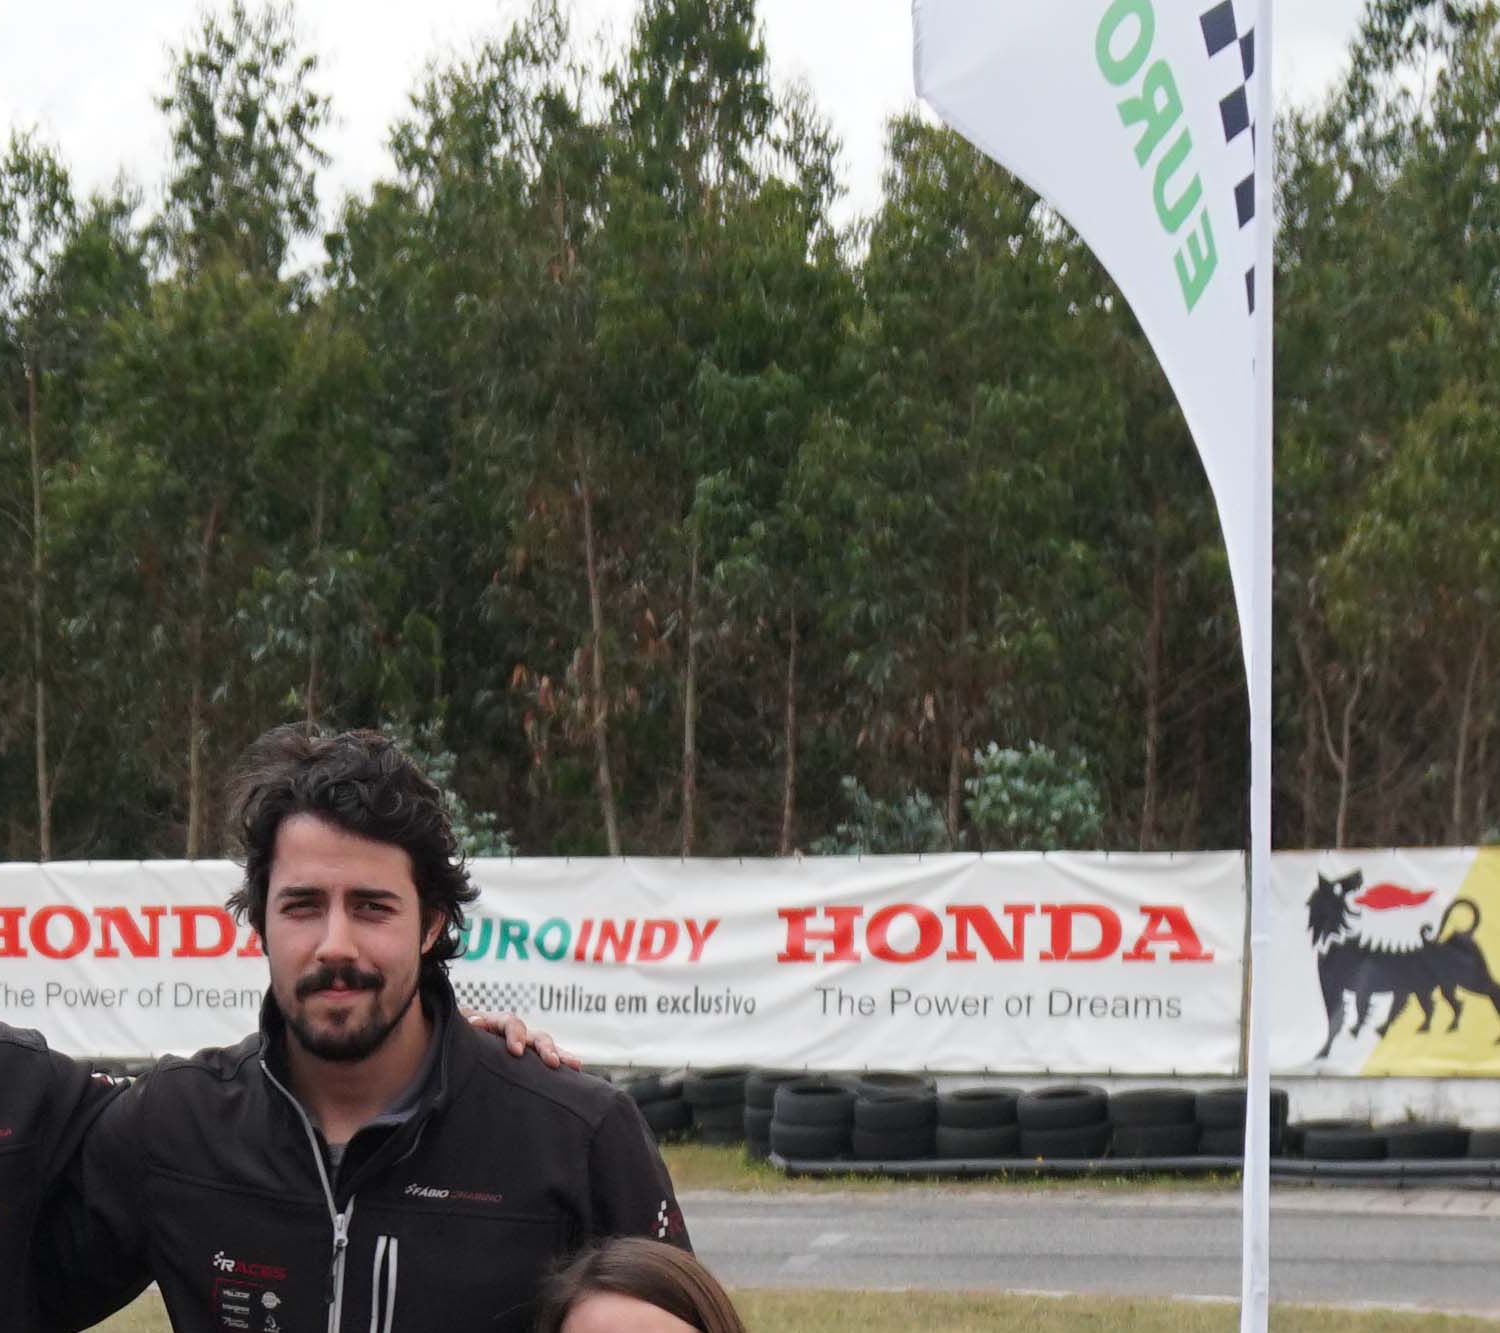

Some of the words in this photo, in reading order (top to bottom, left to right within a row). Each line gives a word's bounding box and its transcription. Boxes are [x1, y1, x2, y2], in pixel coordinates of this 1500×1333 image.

[460, 917, 720, 963] UROINDY
[777, 902, 1214, 964] HONDA
[46, 983, 135, 1009] Power
[142, 982, 166, 1008] of
[174, 983, 264, 1009] Dream
[538, 982, 606, 1013] Utiliza
[614, 993, 650, 1015] em
[656, 984, 757, 1016] exclusivo
[815, 986, 877, 1017] The
[888, 987, 994, 1018] Power
[1004, 986, 1036, 1018] of
[1045, 988, 1183, 1018] Dreams
